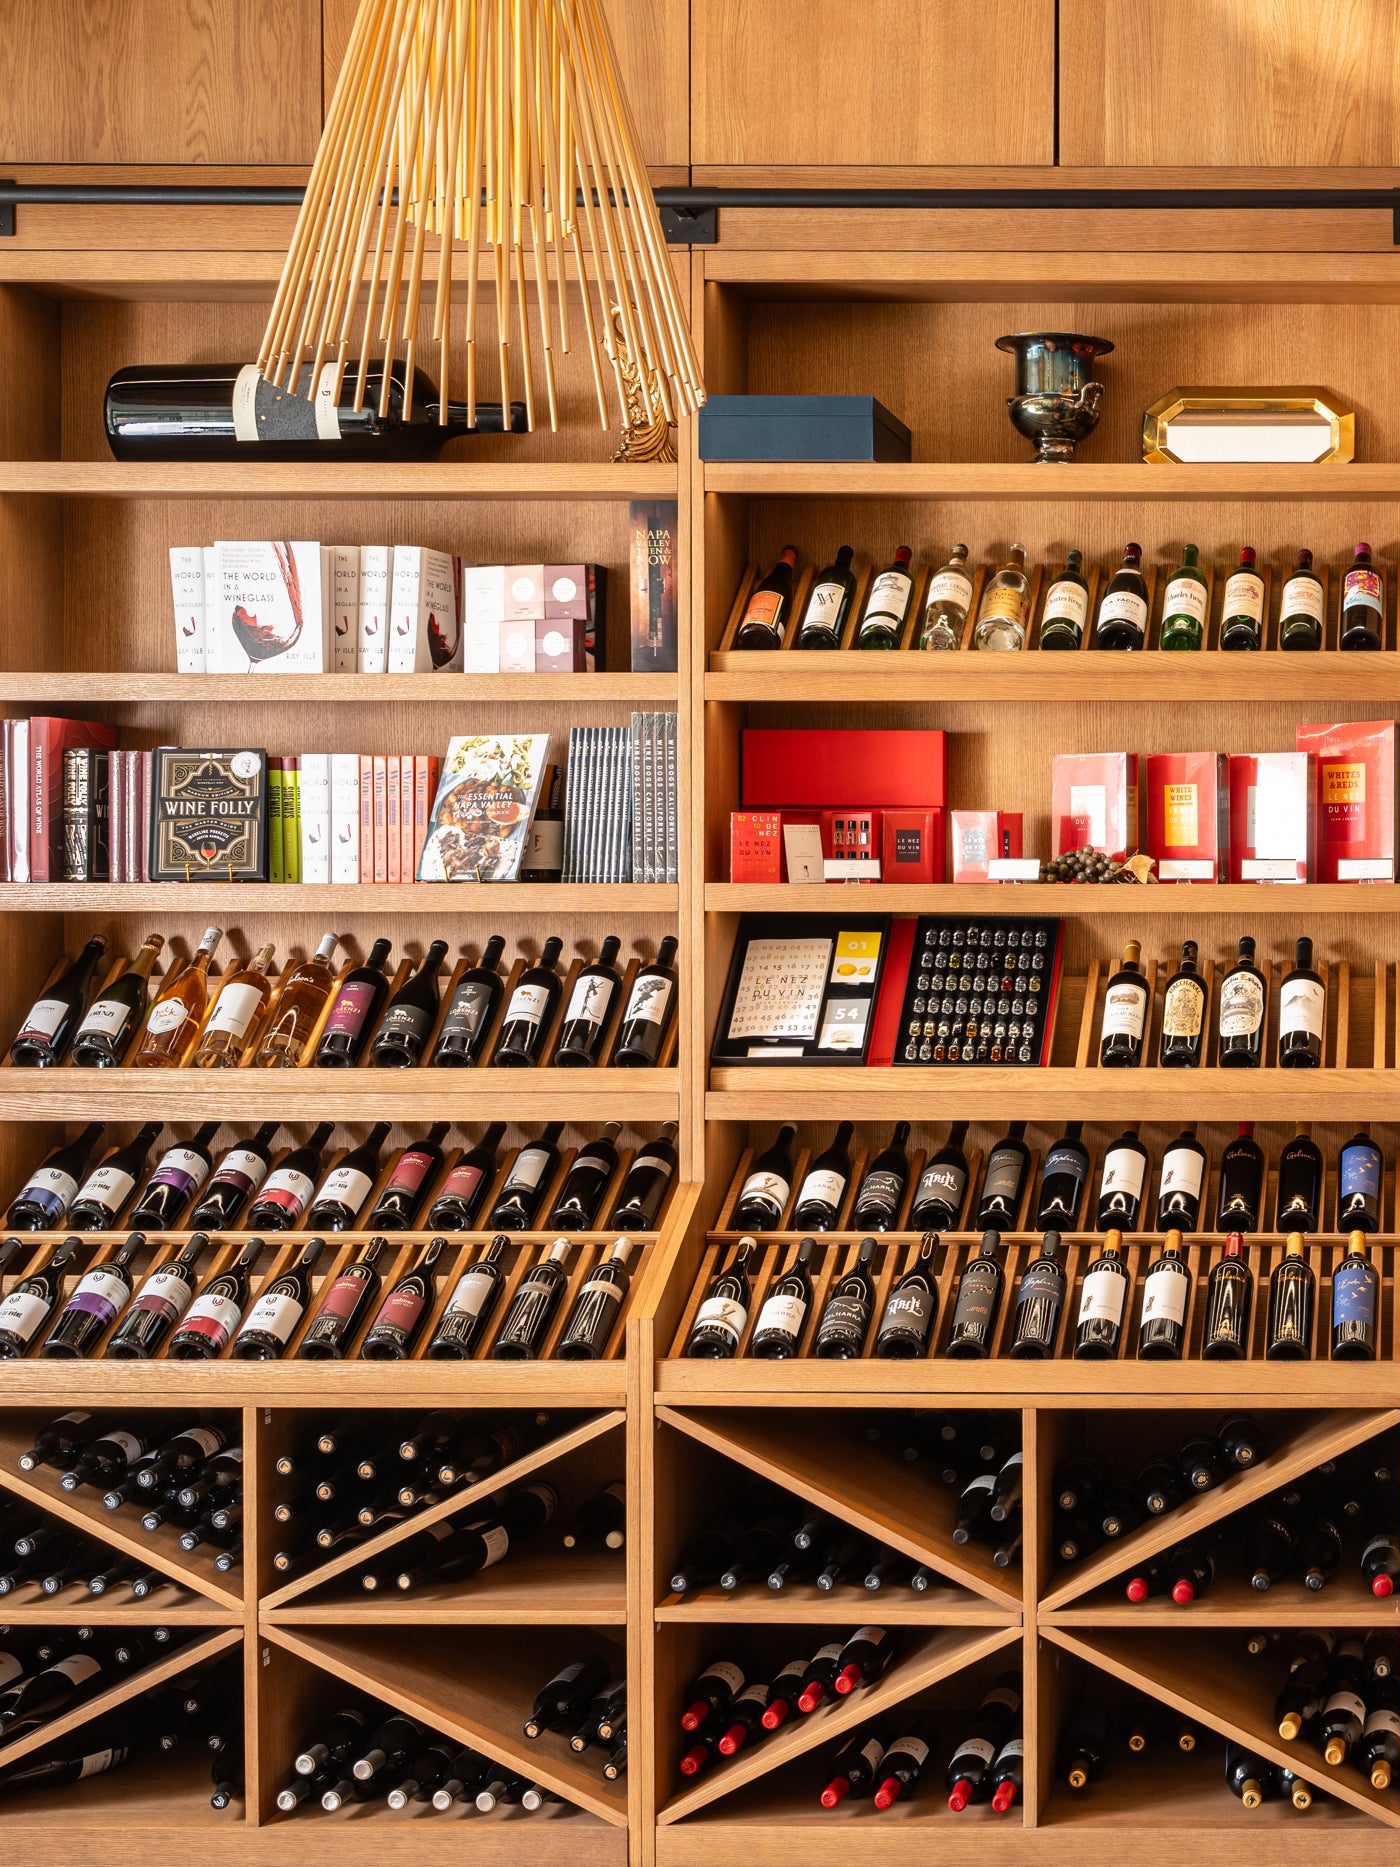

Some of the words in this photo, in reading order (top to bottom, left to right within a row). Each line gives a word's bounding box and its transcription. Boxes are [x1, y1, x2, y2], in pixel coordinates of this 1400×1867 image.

[635, 529, 671, 540] NAPA
[636, 555, 671, 565] NOW
[174, 571, 201, 579] WORLD
[223, 572, 239, 581] THE
[243, 572, 277, 581] WORLD
[435, 582, 452, 593] WORLD
[223, 593, 275, 602] WINEGLASS
[425, 600, 450, 612] WINEGLASS
[35, 745, 43, 760] THE
[35, 761, 43, 784] WORLD
[1327, 771, 1361, 780] WHITES
[1329, 781, 1359, 789] &REDS
[211, 789, 234, 797] EDITION
[1169, 786, 1193, 794] WHITE
[35, 785, 43, 808] ATLAS
[467, 792, 514, 800] ESSENTIAL
[1328, 793, 1338, 801] LE
[1343, 792, 1360, 801] NEZ
[269, 785, 281, 818] SIDEWAYS
[283, 786, 295, 819] SIDEWAYS
[453, 801, 478, 809] NAPA
[481, 801, 513, 809] VALLEY
[165, 800, 207, 816] WINE
[210, 800, 254, 816] FOLLY
[1328, 806, 1339, 814] DU
[1343, 805, 1360, 813] VIN
[35, 818, 43, 834] WINE
[848, 941, 868, 950] 01
[780, 976, 808, 984] NEZ
[753, 989, 770, 997] DU
[778, 989, 806, 997] VIN
[834, 1007, 859, 1020] 54
